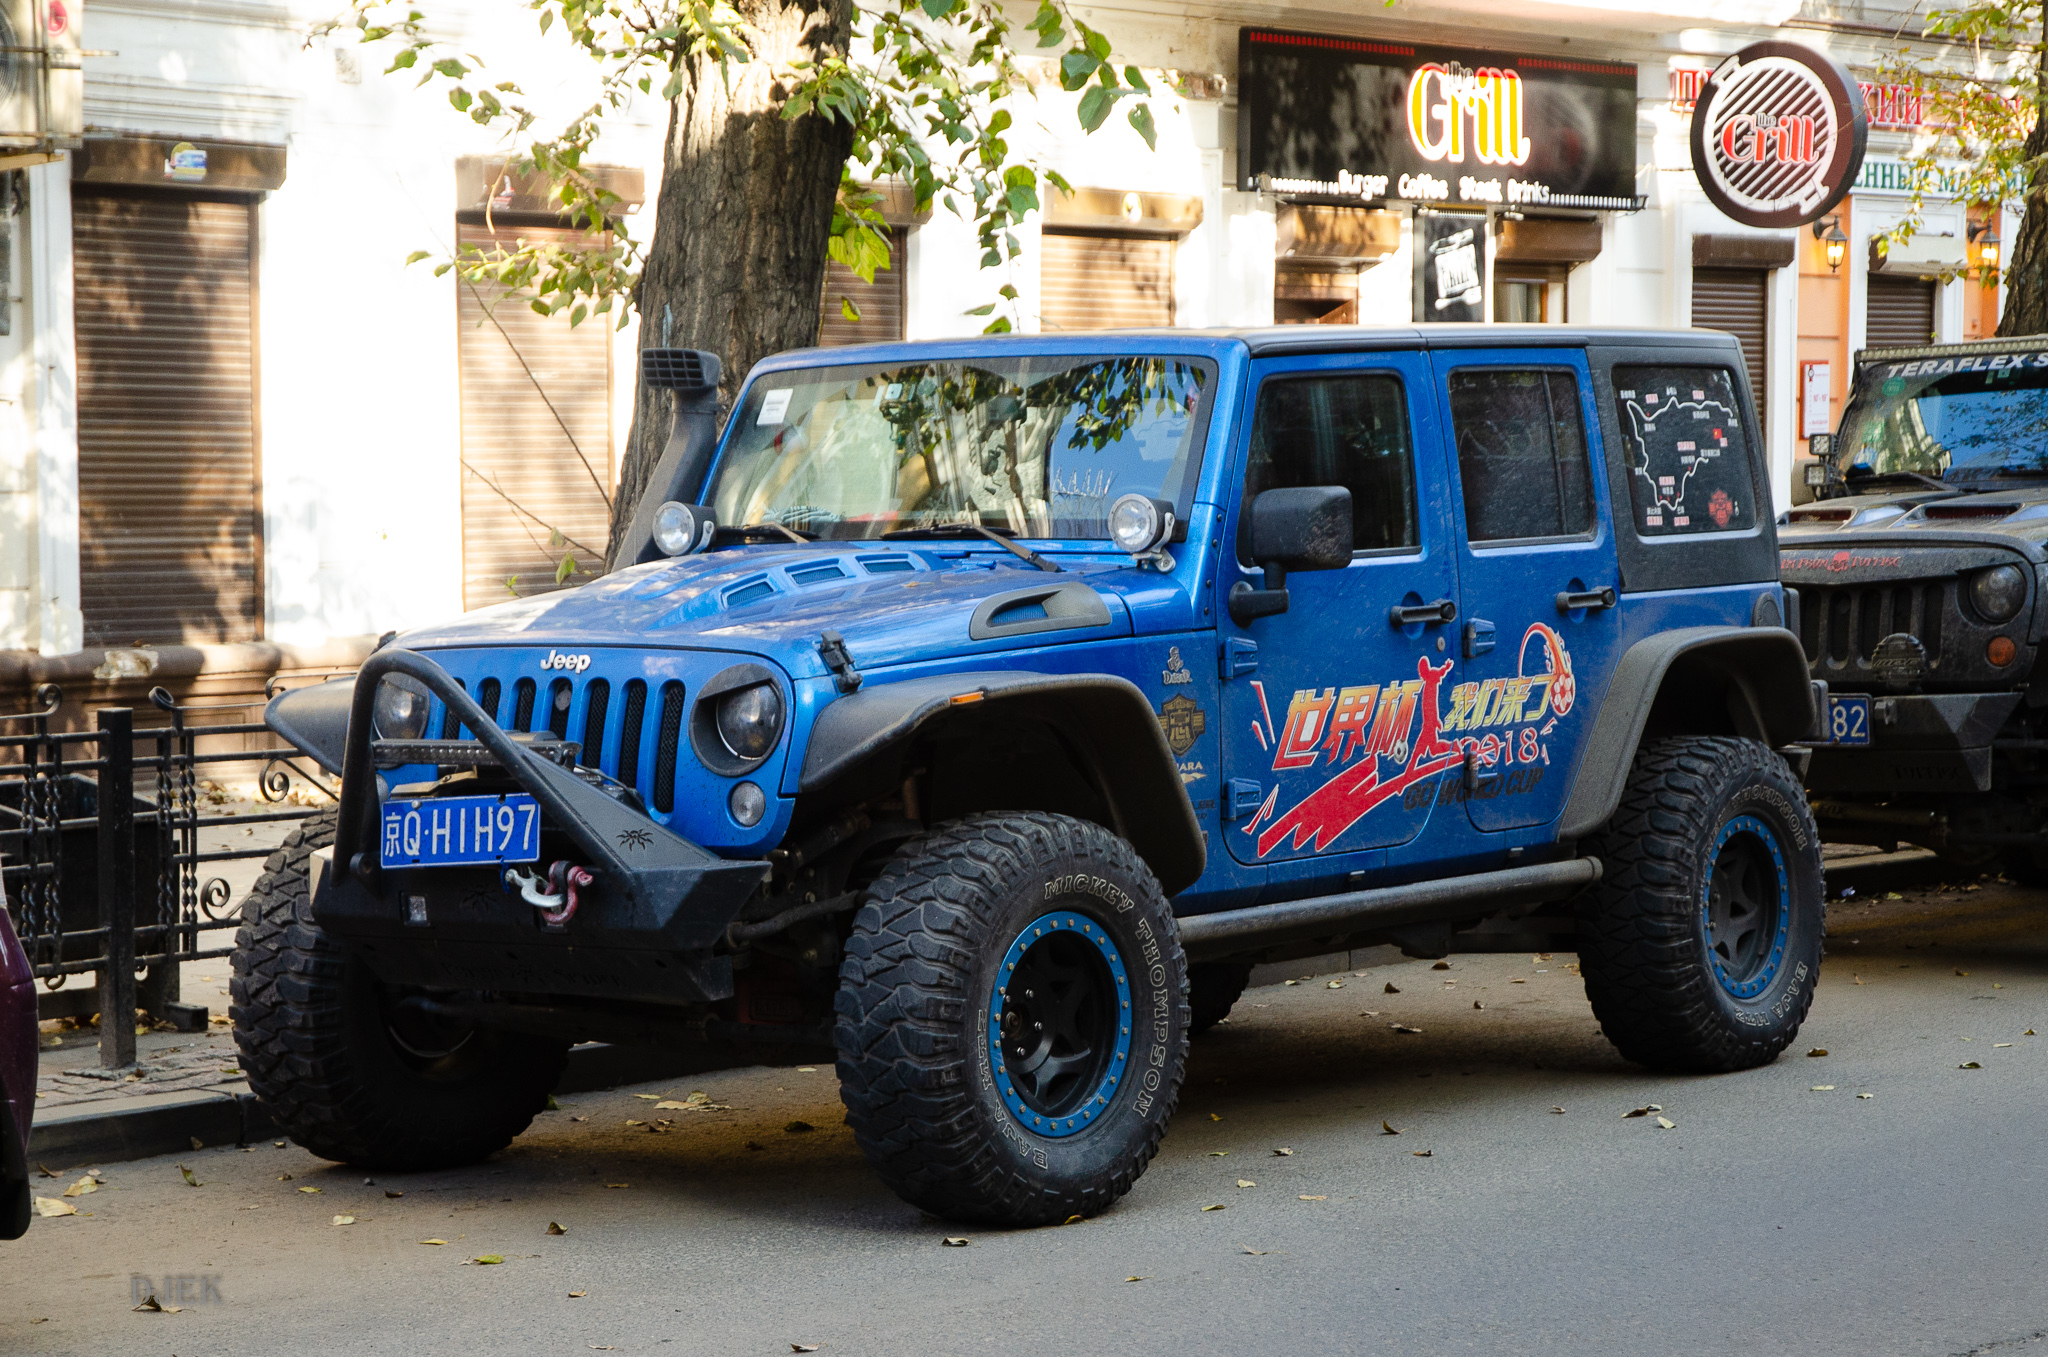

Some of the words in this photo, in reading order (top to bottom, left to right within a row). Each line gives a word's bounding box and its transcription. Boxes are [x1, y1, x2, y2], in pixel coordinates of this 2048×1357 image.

[1407, 63, 1531, 166] Grill
[1756, 112, 1777, 127] the
[1721, 113, 1819, 165] Grill
[1338, 169, 1388, 201] Burger
[1398, 173, 1448, 199] Coffee
[1459, 175, 1503, 202] Steak
[1507, 178, 1550, 204] Drinks
[1887, 354, 2029, 378] TERAFLEX
[540, 650, 591, 674] Jeep
[1271, 679, 1425, 771] 世界杯
[1832, 705, 1866, 737] 82
[1505, 767, 1545, 797] CUP
[1044, 873, 1135, 914] MICKEY
[1133, 917, 1170, 1117] THOMPSON
[1771, 960, 1808, 1018] BAJA
[993, 1099, 1048, 1170] BAJA
